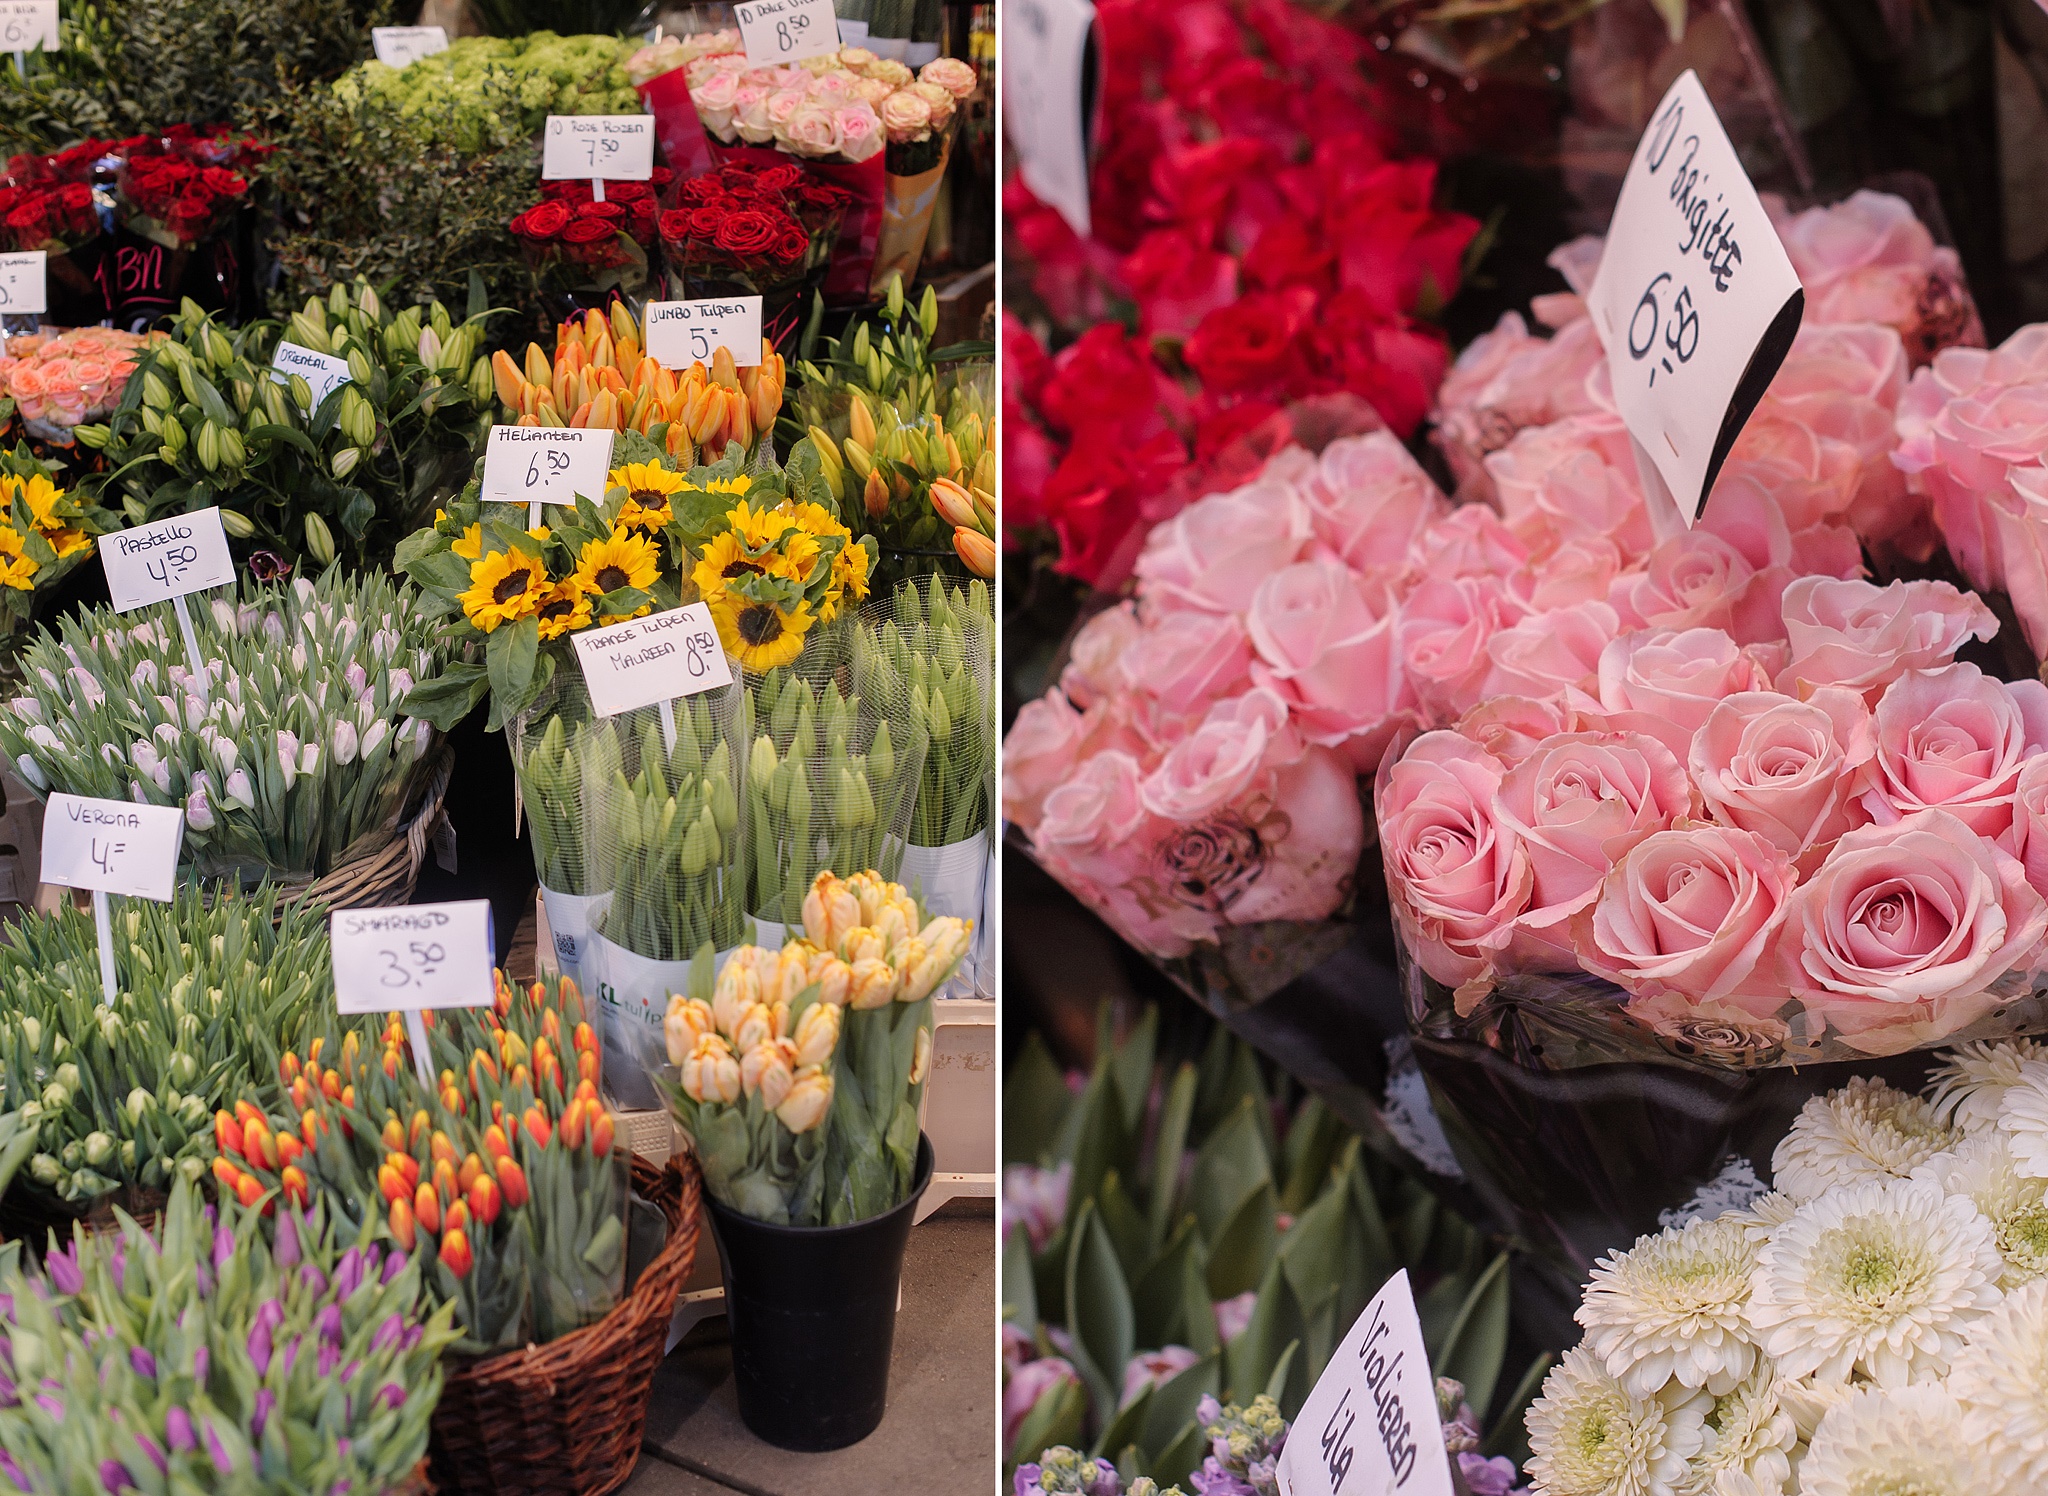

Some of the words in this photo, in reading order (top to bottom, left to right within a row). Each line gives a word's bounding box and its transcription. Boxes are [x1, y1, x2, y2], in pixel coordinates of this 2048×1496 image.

[650, 307, 691, 324] JUMBO
[610, 642, 675, 671] MAUREEN
[67, 802, 140, 828] VERONA
